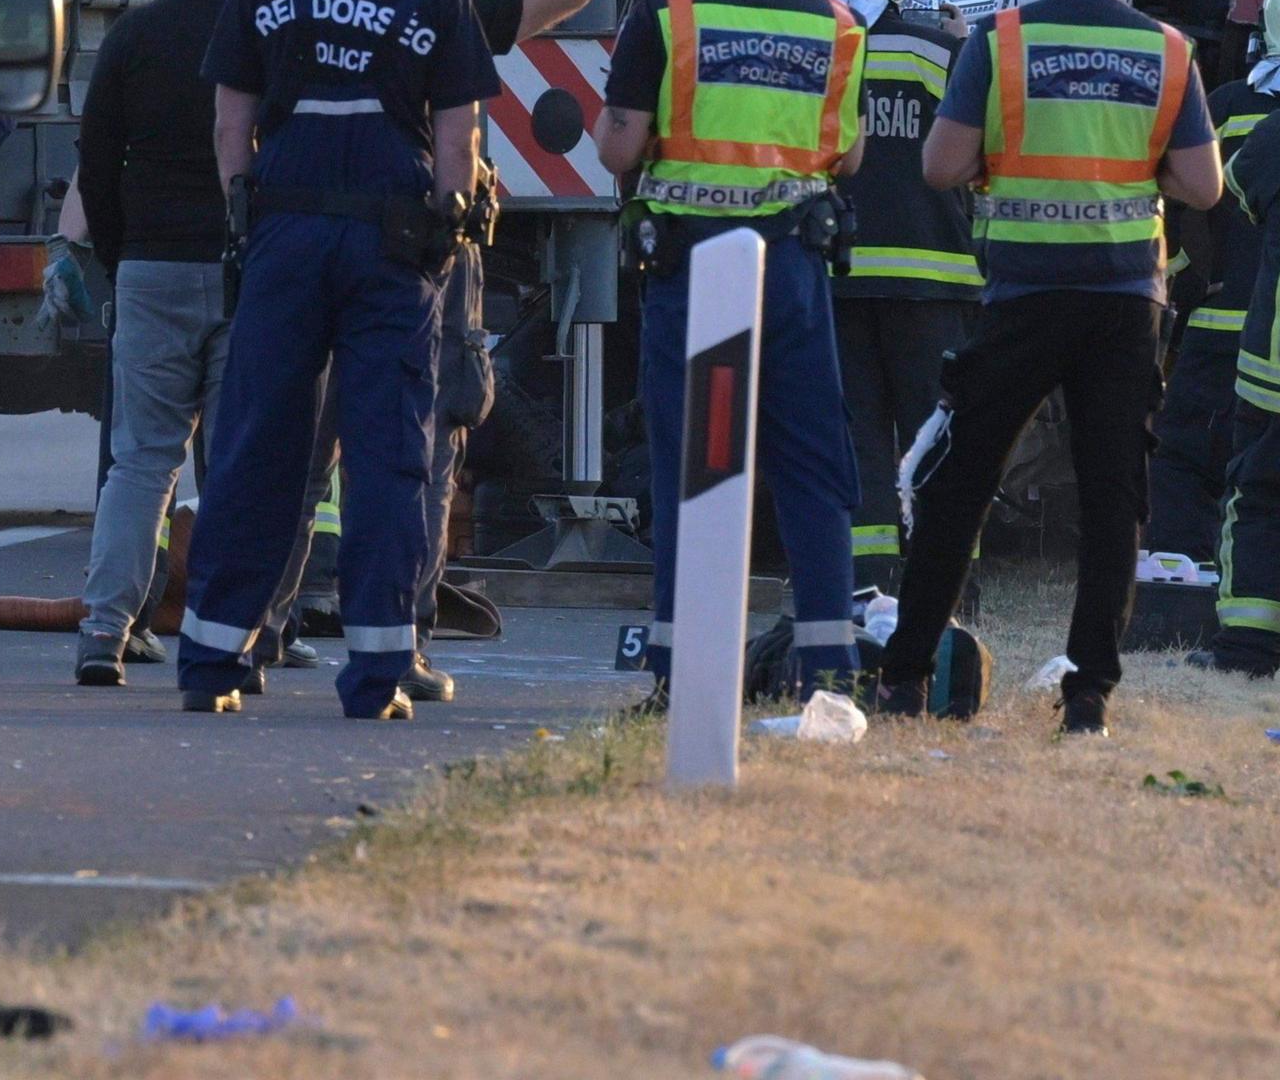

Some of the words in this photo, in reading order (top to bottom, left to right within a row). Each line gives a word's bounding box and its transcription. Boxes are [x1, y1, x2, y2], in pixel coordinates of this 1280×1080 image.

[739, 65, 790, 86] POLICE
[1069, 81, 1122, 98] POLICE
[1029, 201, 1109, 221] POLICE
[622, 627, 643, 658] 5
